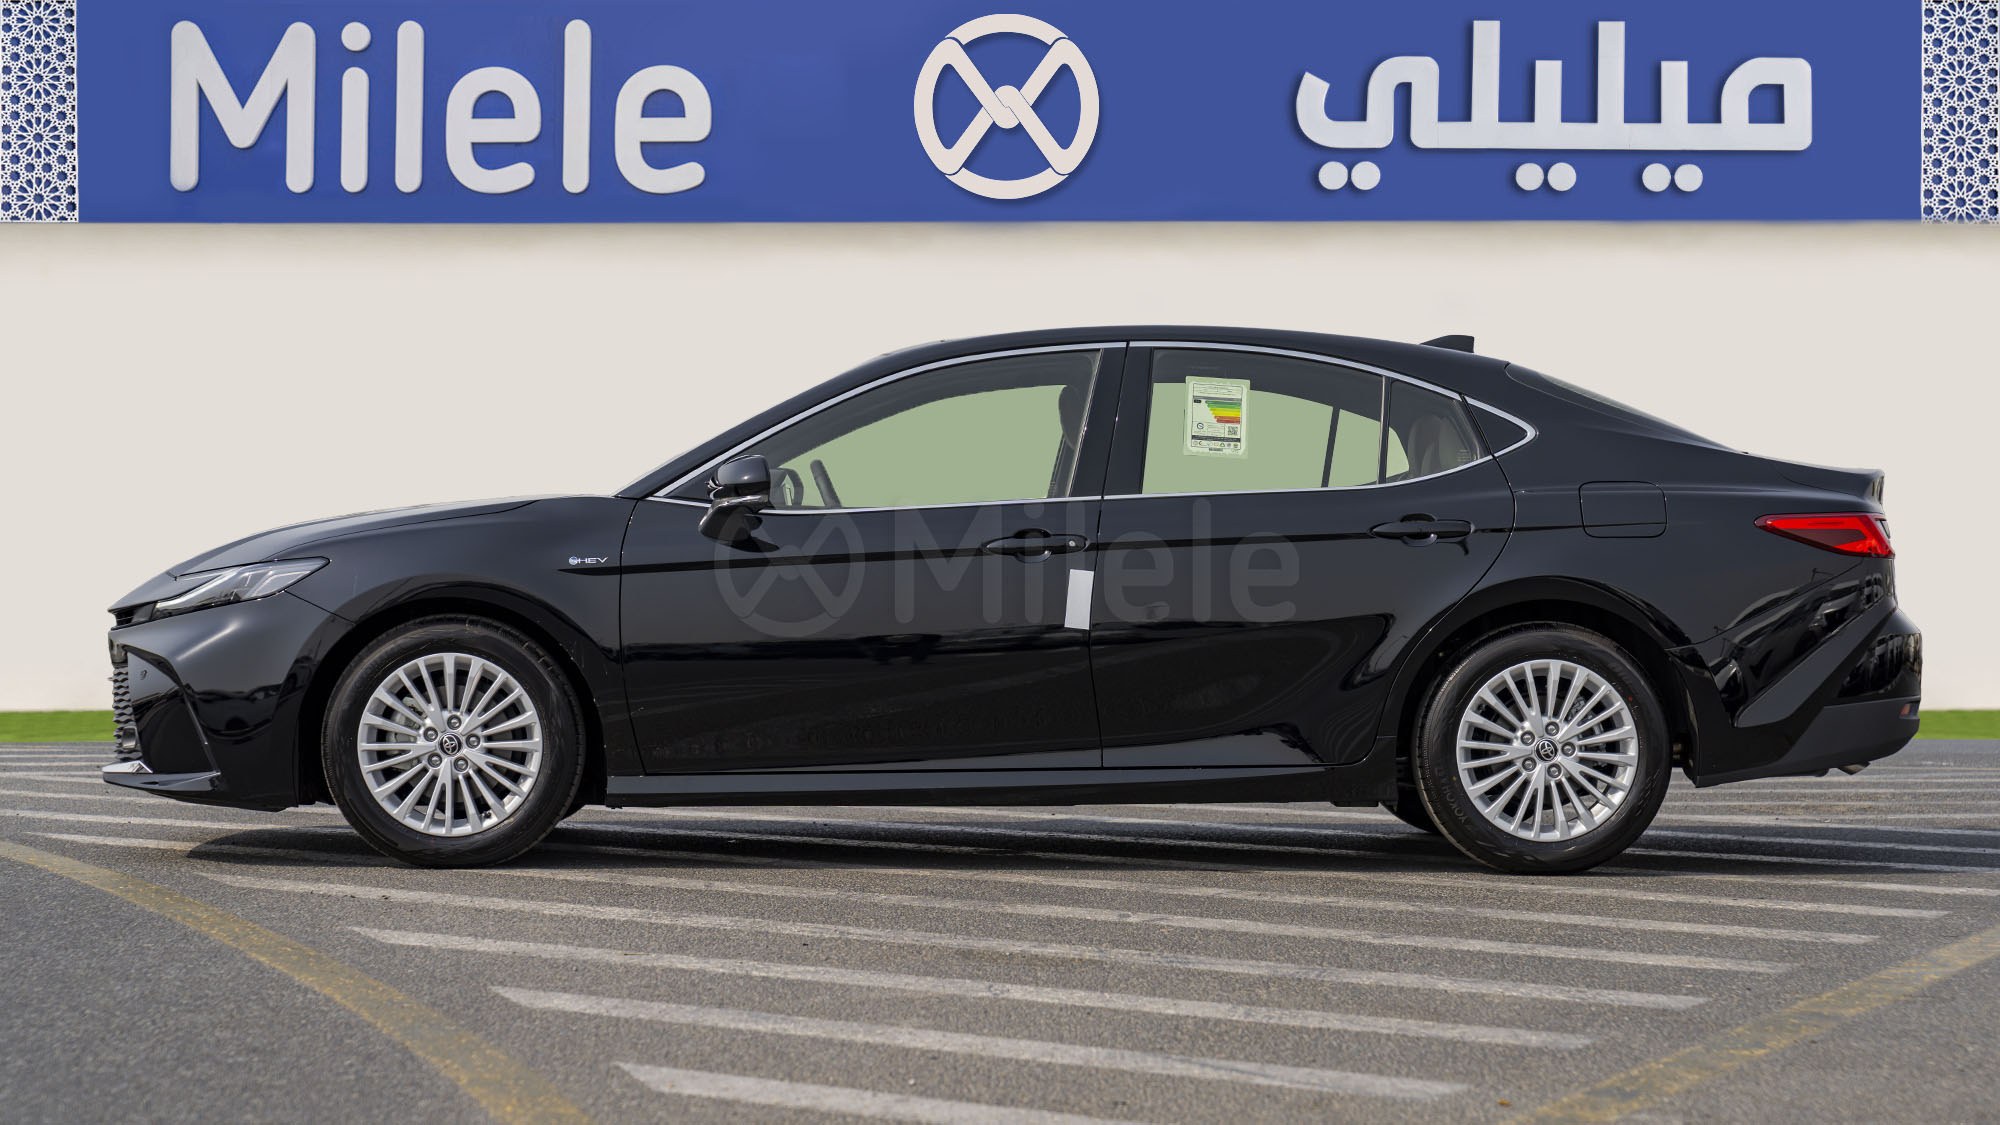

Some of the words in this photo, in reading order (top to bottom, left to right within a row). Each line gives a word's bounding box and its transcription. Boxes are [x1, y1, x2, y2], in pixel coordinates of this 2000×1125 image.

[170, 19, 712, 194] Milele
[1296, 20, 1812, 192] ميليلي
[578, 556, 609, 564] HEV
